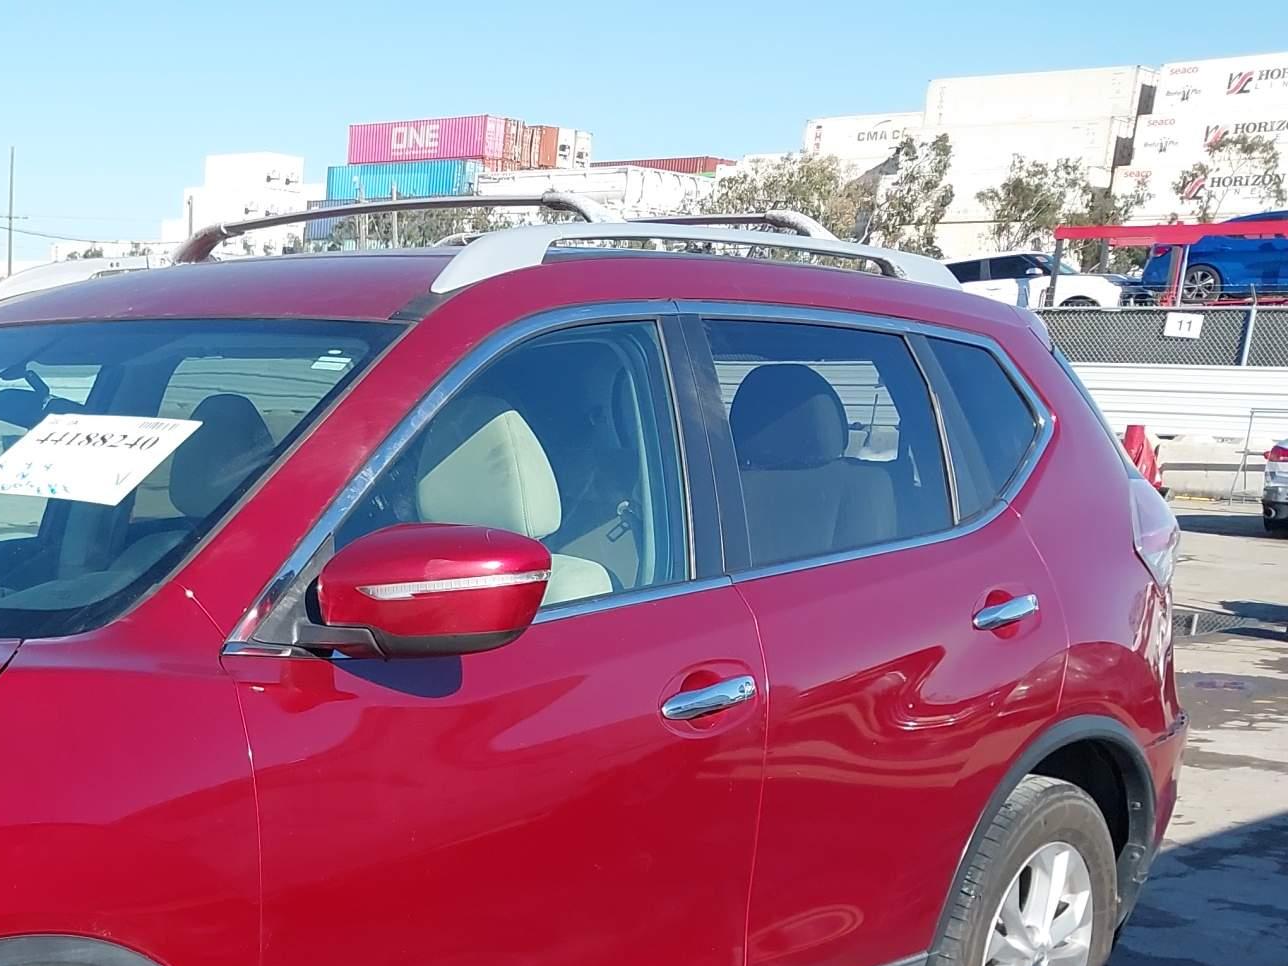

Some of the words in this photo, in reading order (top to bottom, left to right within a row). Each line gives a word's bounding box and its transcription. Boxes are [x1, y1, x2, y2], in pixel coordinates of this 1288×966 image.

[1233, 120, 1288, 134] HORIZ
[391, 124, 440, 149] ONE
[857, 130, 888, 142] CMA
[1210, 173, 1287, 188] HORIZON
[1178, 320, 1192, 332] 11
[35, 430, 161, 451] 44188240
